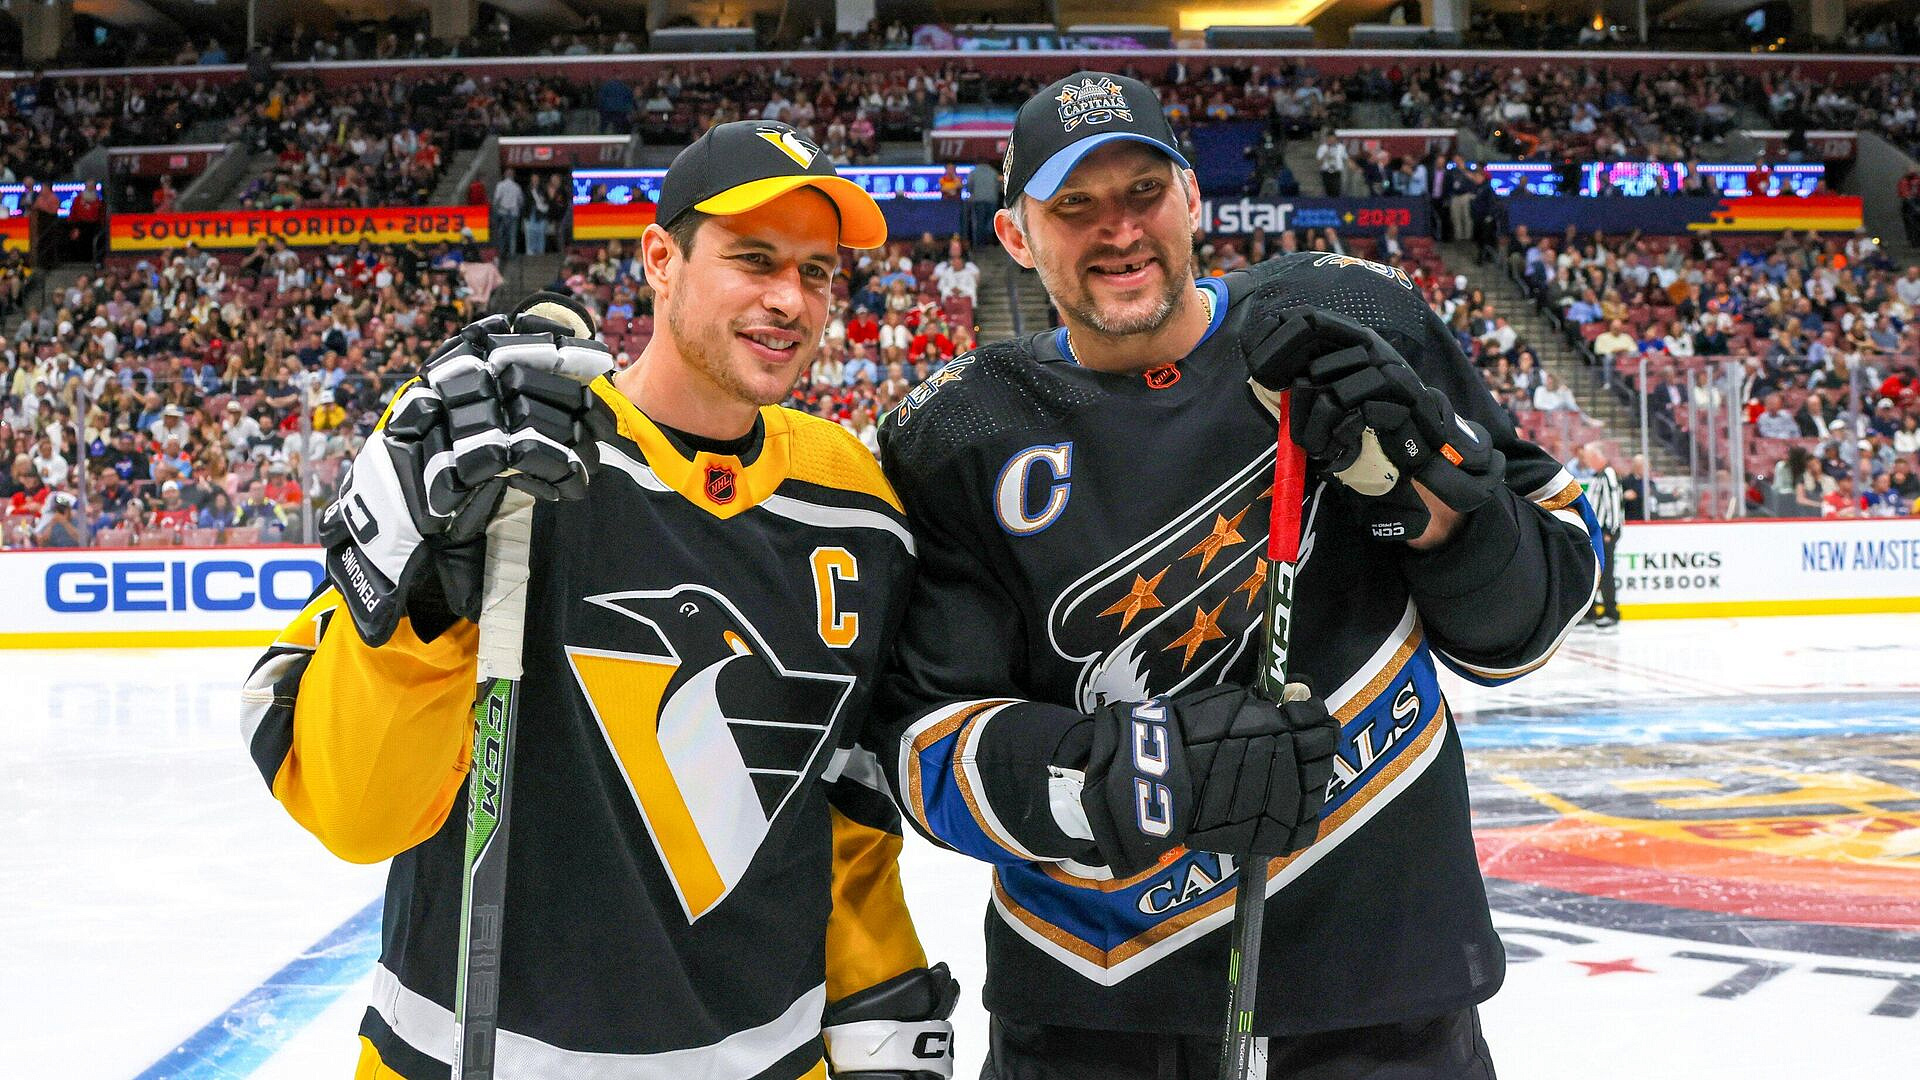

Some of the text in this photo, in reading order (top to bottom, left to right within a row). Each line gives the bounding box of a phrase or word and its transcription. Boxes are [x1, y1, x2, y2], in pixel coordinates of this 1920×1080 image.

[1064, 97, 1126, 116] CAPITALS
[131, 213, 465, 240] SOUTH FLORIDA 2023
[1357, 208, 1411, 226] 2023
[711, 475, 731, 494] NHL
[993, 441, 1073, 537] C
[1372, 526, 1405, 537] CCM
[1802, 541, 1847, 571] NEW
[45, 560, 325, 613] GEICO
[342, 546, 381, 613] PENGUINS
[809, 546, 859, 648] C
[1270, 561, 1296, 685] CCM
[482, 693, 505, 819] CCM
